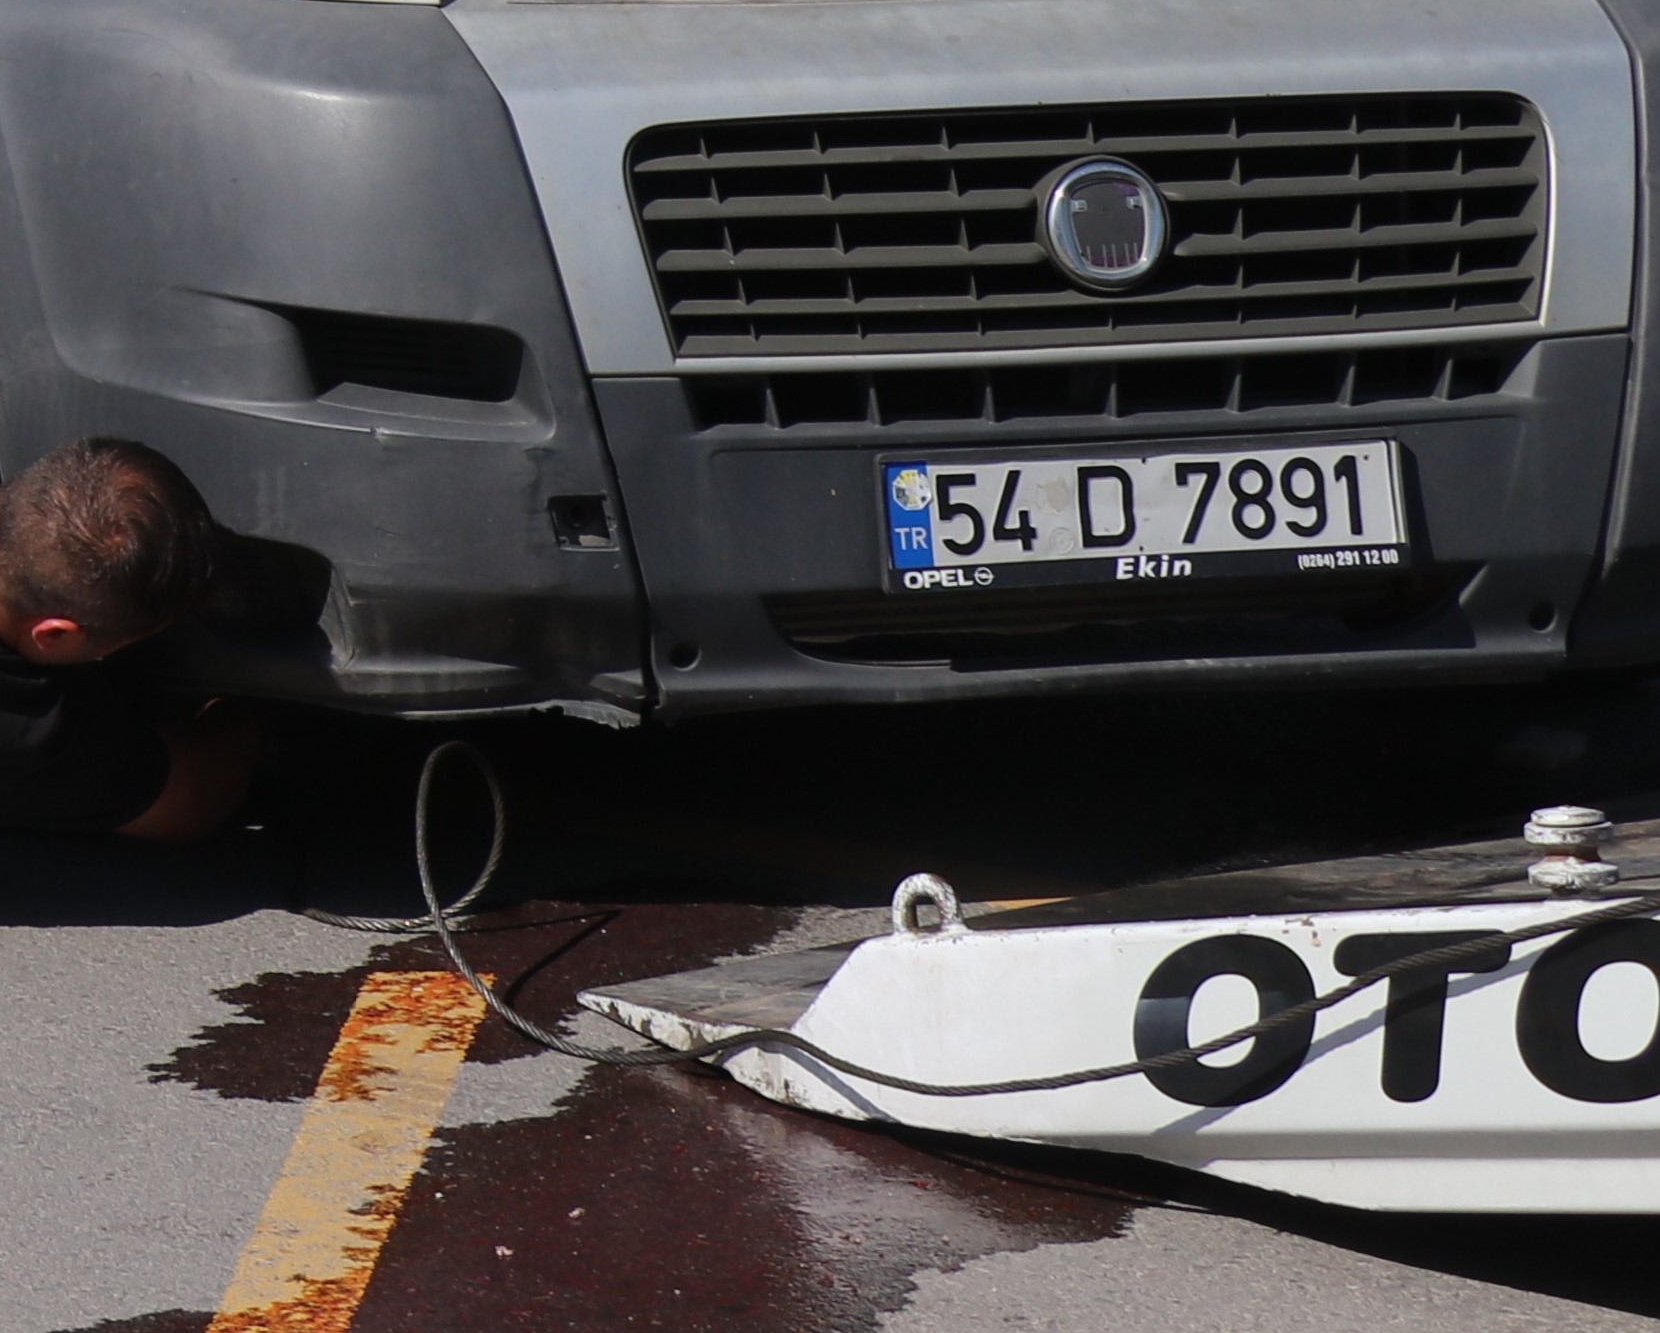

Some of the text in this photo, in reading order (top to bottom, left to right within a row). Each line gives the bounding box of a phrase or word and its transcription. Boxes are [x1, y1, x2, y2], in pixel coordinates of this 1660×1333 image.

[936, 455, 1364, 555] 54 D 7891
[894, 527, 929, 550] TR
[1116, 554, 1193, 580] Ekin
[1298, 553, 1335, 571] (0264)
[1336, 550, 1360, 566] 291
[904, 569, 972, 589] OPEL
